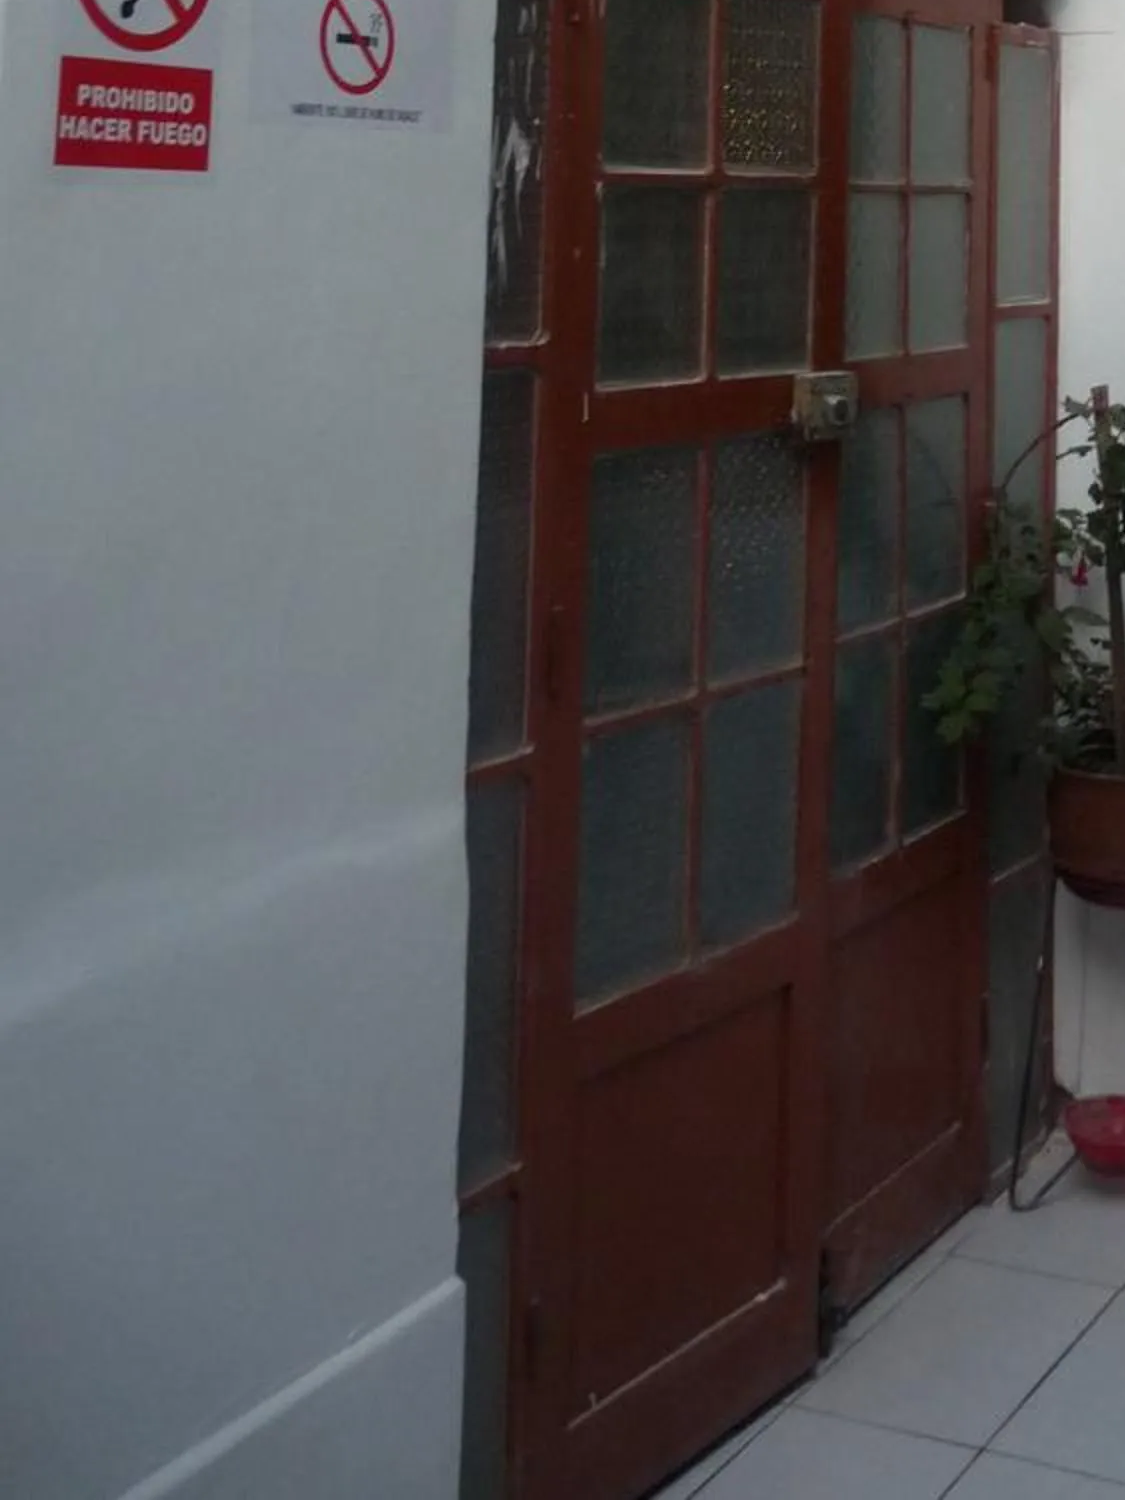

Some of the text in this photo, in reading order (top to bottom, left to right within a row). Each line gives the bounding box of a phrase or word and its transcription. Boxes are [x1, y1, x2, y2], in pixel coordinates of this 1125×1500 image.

[76, 84, 195, 114] PROHIBIDO
[59, 115, 207, 147] HACER FUEGO
